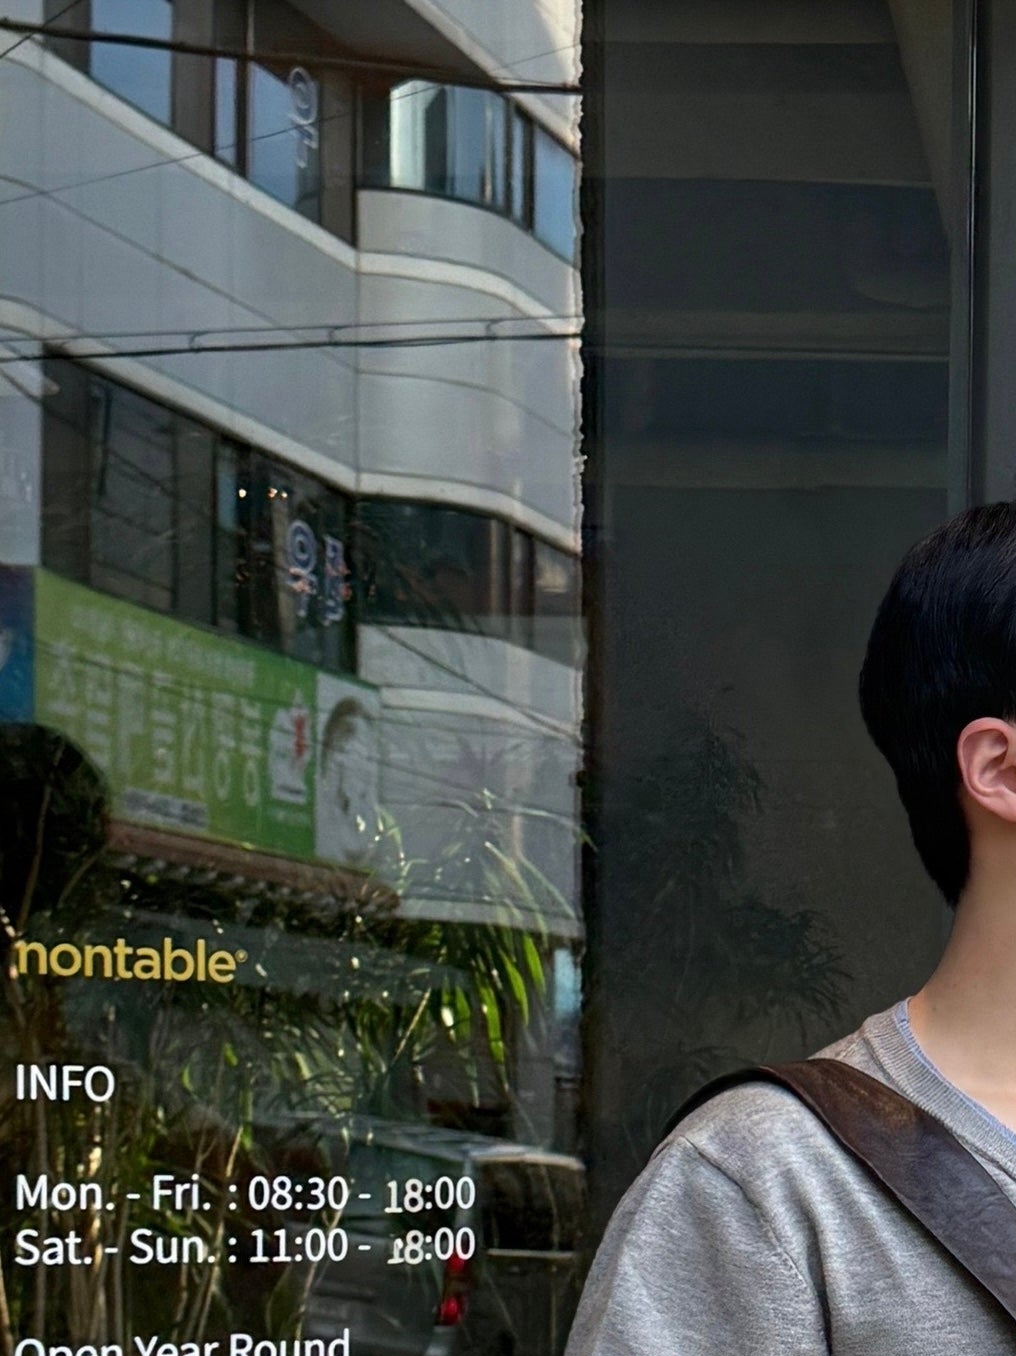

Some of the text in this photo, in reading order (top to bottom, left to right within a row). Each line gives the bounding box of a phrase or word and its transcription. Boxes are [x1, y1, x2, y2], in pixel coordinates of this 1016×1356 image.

[16, 1064, 115, 1102] INFO
[15, 1174, 115, 1211] Mon.
[152, 1173, 211, 1211] Fri.
[248, 1175, 349, 1211] 08:30
[384, 1176, 476, 1213] 18:00
[14, 1228, 93, 1266] Sat.
[129, 1228, 216, 1264] Sun.
[250, 1227, 349, 1263] 11:00
[387, 1226, 476, 1265] 18:00
